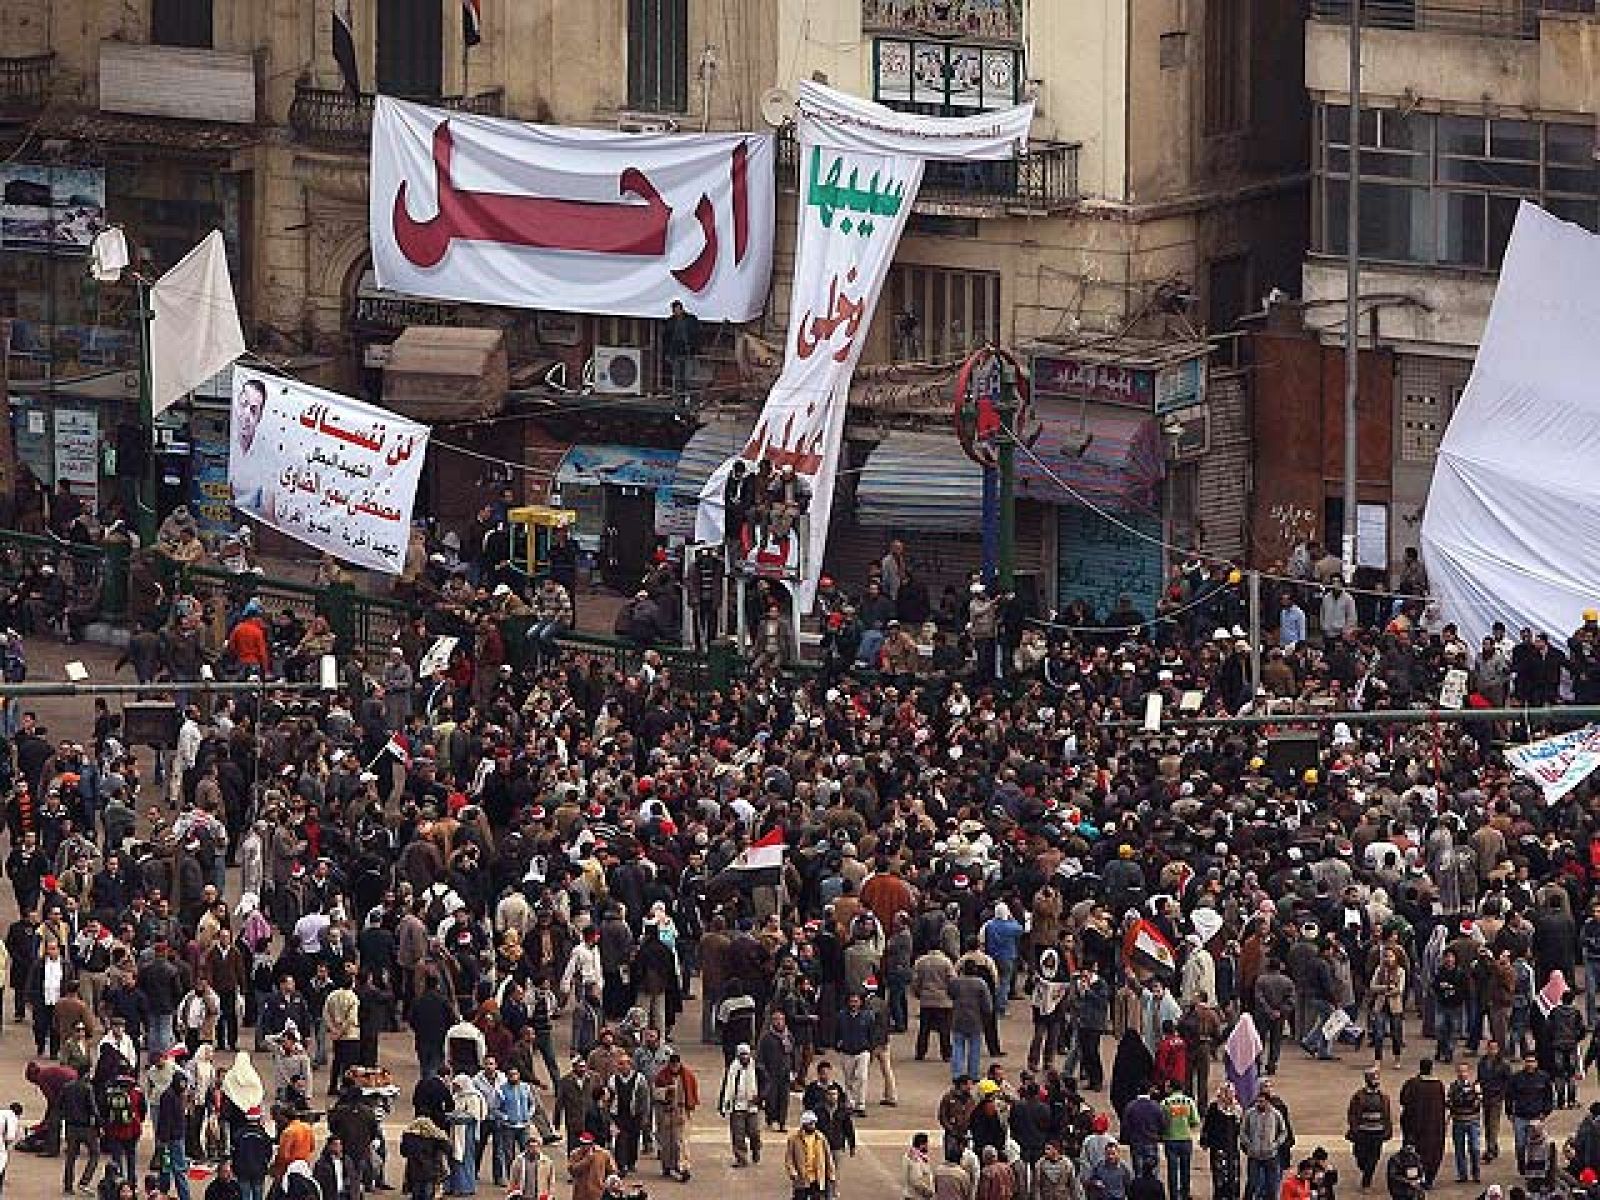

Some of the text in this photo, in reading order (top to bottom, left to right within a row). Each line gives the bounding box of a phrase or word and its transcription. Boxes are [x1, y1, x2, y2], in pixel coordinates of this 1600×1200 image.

[393, 116, 748, 292] ارحل
[808, 145, 905, 238] سيبها
[387, 434, 414, 466] لن
